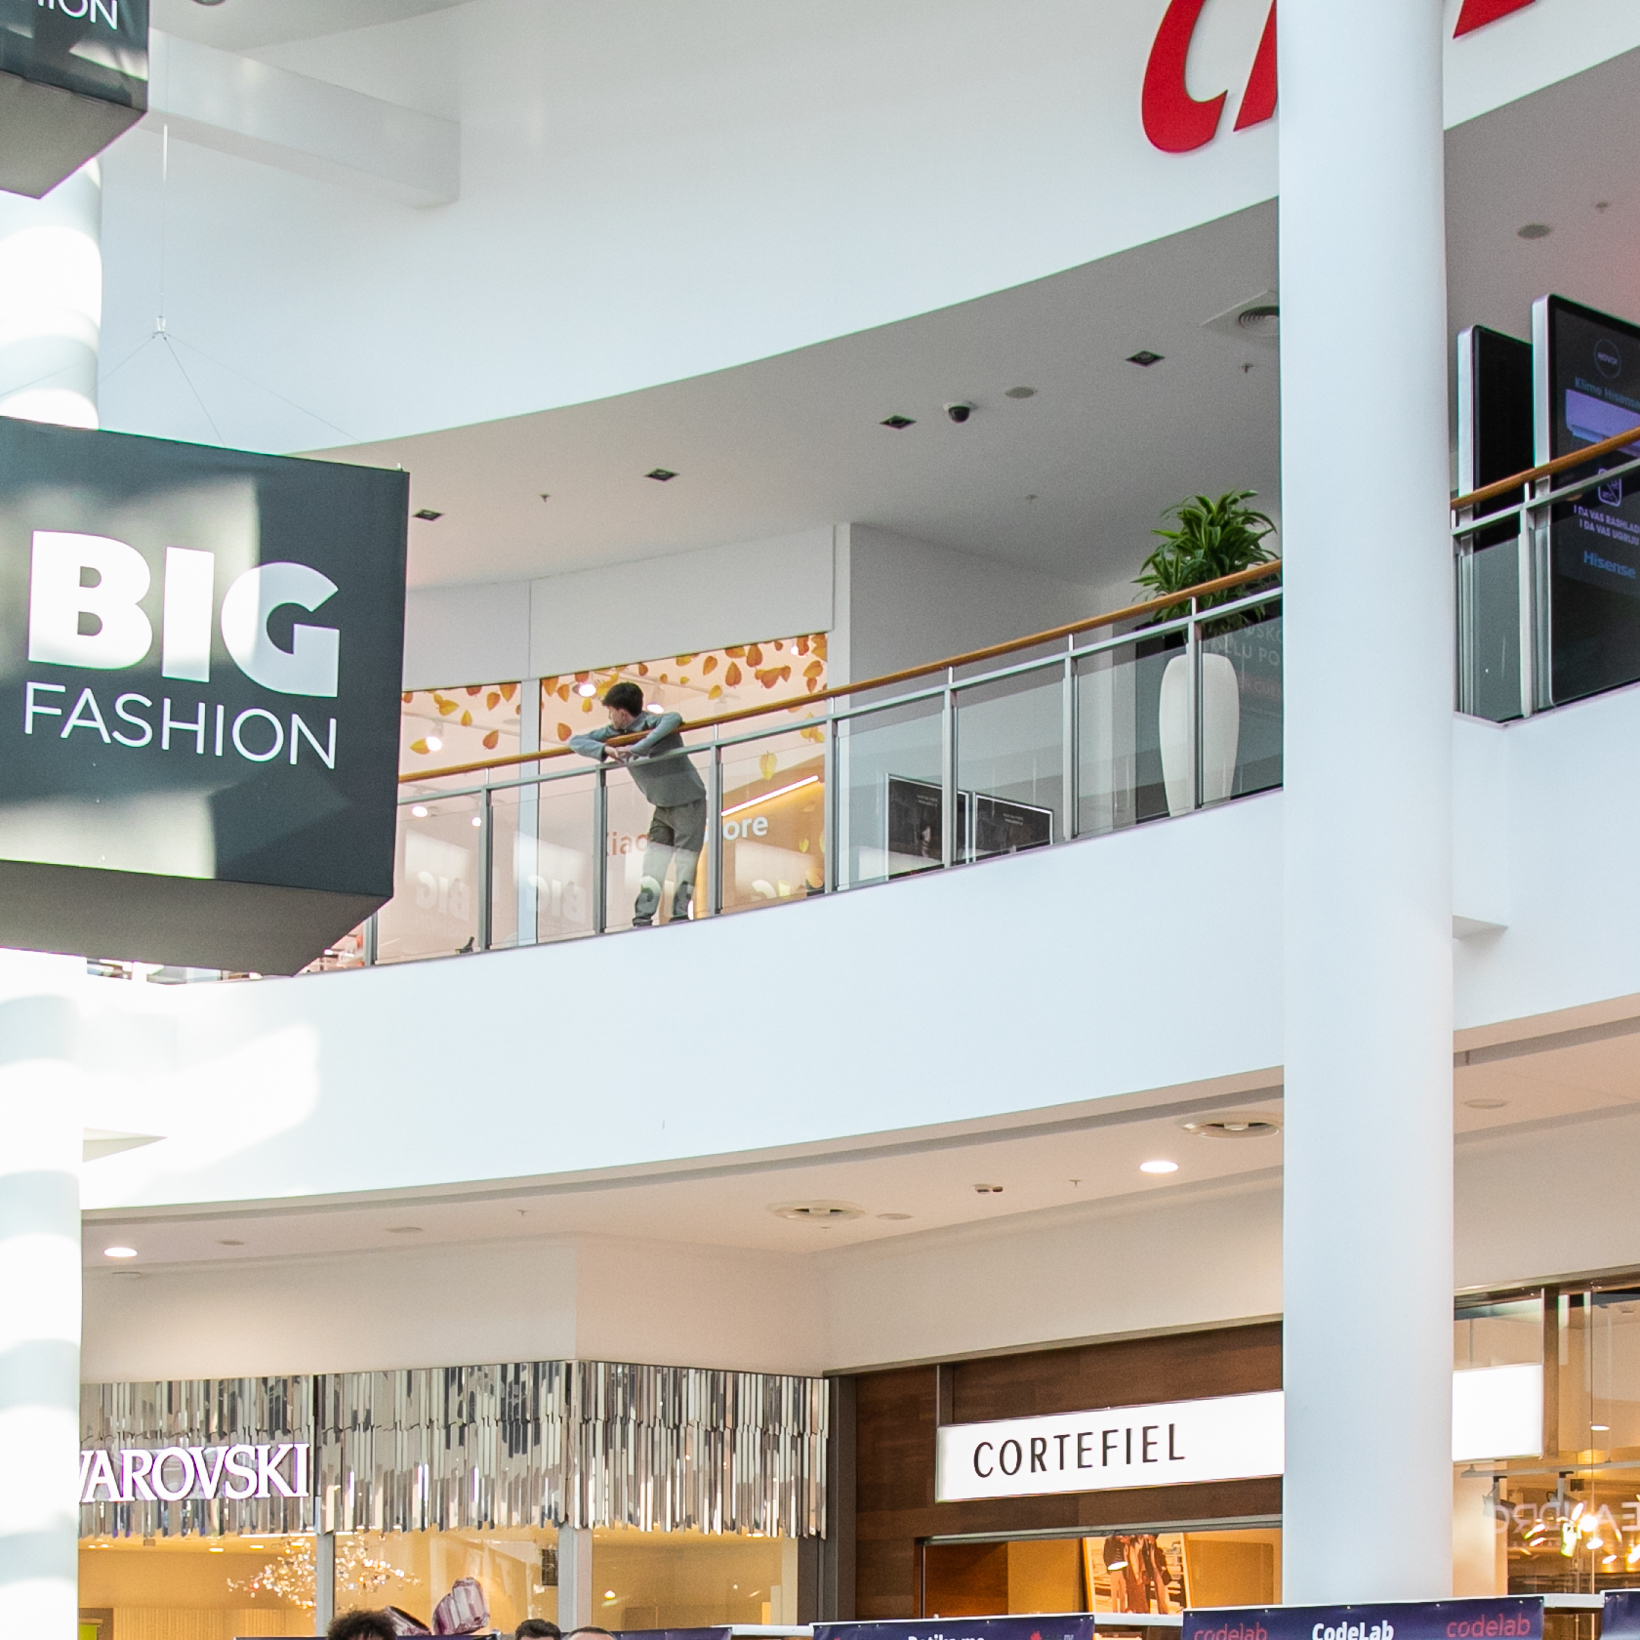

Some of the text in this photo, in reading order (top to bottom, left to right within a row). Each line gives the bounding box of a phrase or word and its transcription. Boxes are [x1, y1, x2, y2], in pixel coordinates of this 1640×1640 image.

[1583, 550, 1636, 579] Hisense
[28, 530, 339, 698] BIG
[24, 683, 337, 770] FASHION
[79, 1442, 309, 1503] AROVSKI
[973, 1422, 1186, 1480] CORTEFIEL
[1446, 1613, 1531, 1638] codelab
